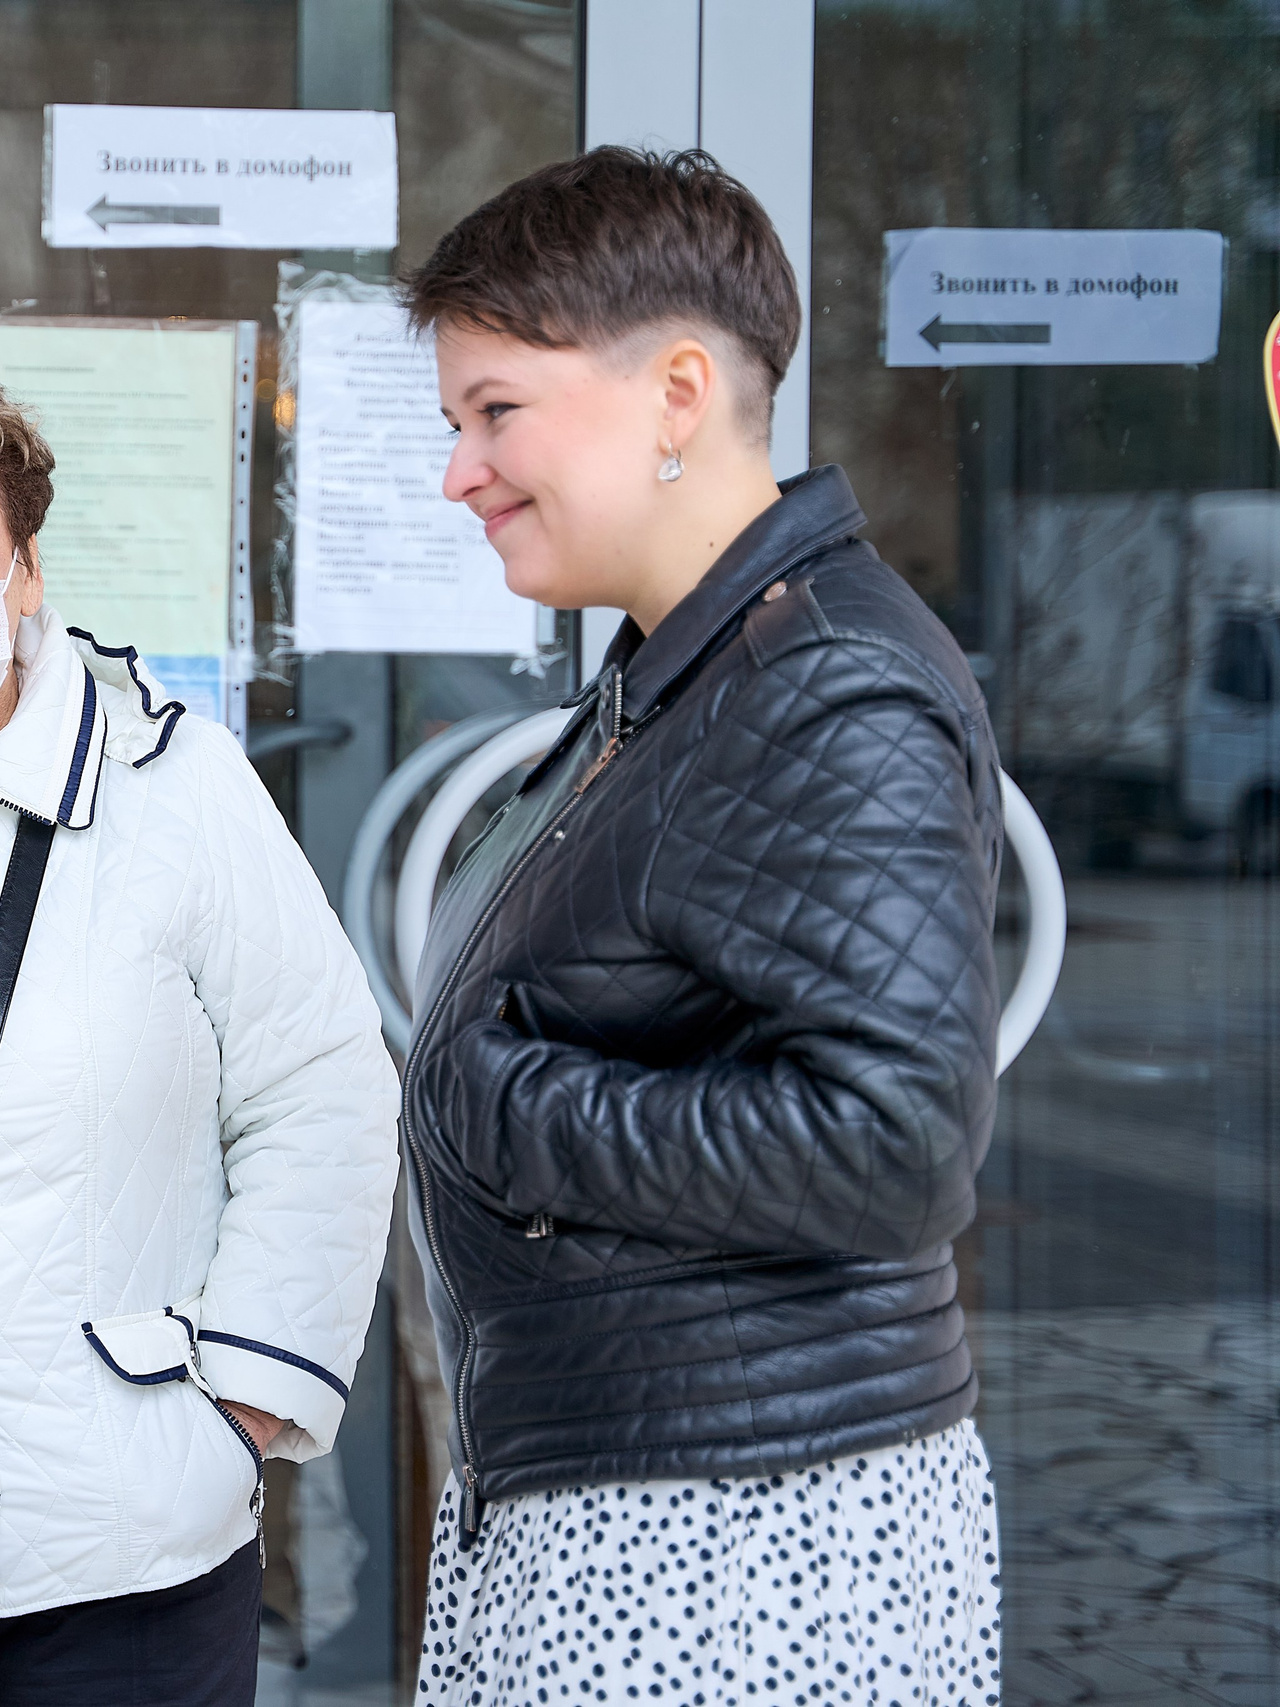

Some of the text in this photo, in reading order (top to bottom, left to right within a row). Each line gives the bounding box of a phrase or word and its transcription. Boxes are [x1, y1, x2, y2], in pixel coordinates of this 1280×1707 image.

[97, 150, 353, 182] Звонить в домофон
[931, 271, 1179, 300] Звонить в домофон
